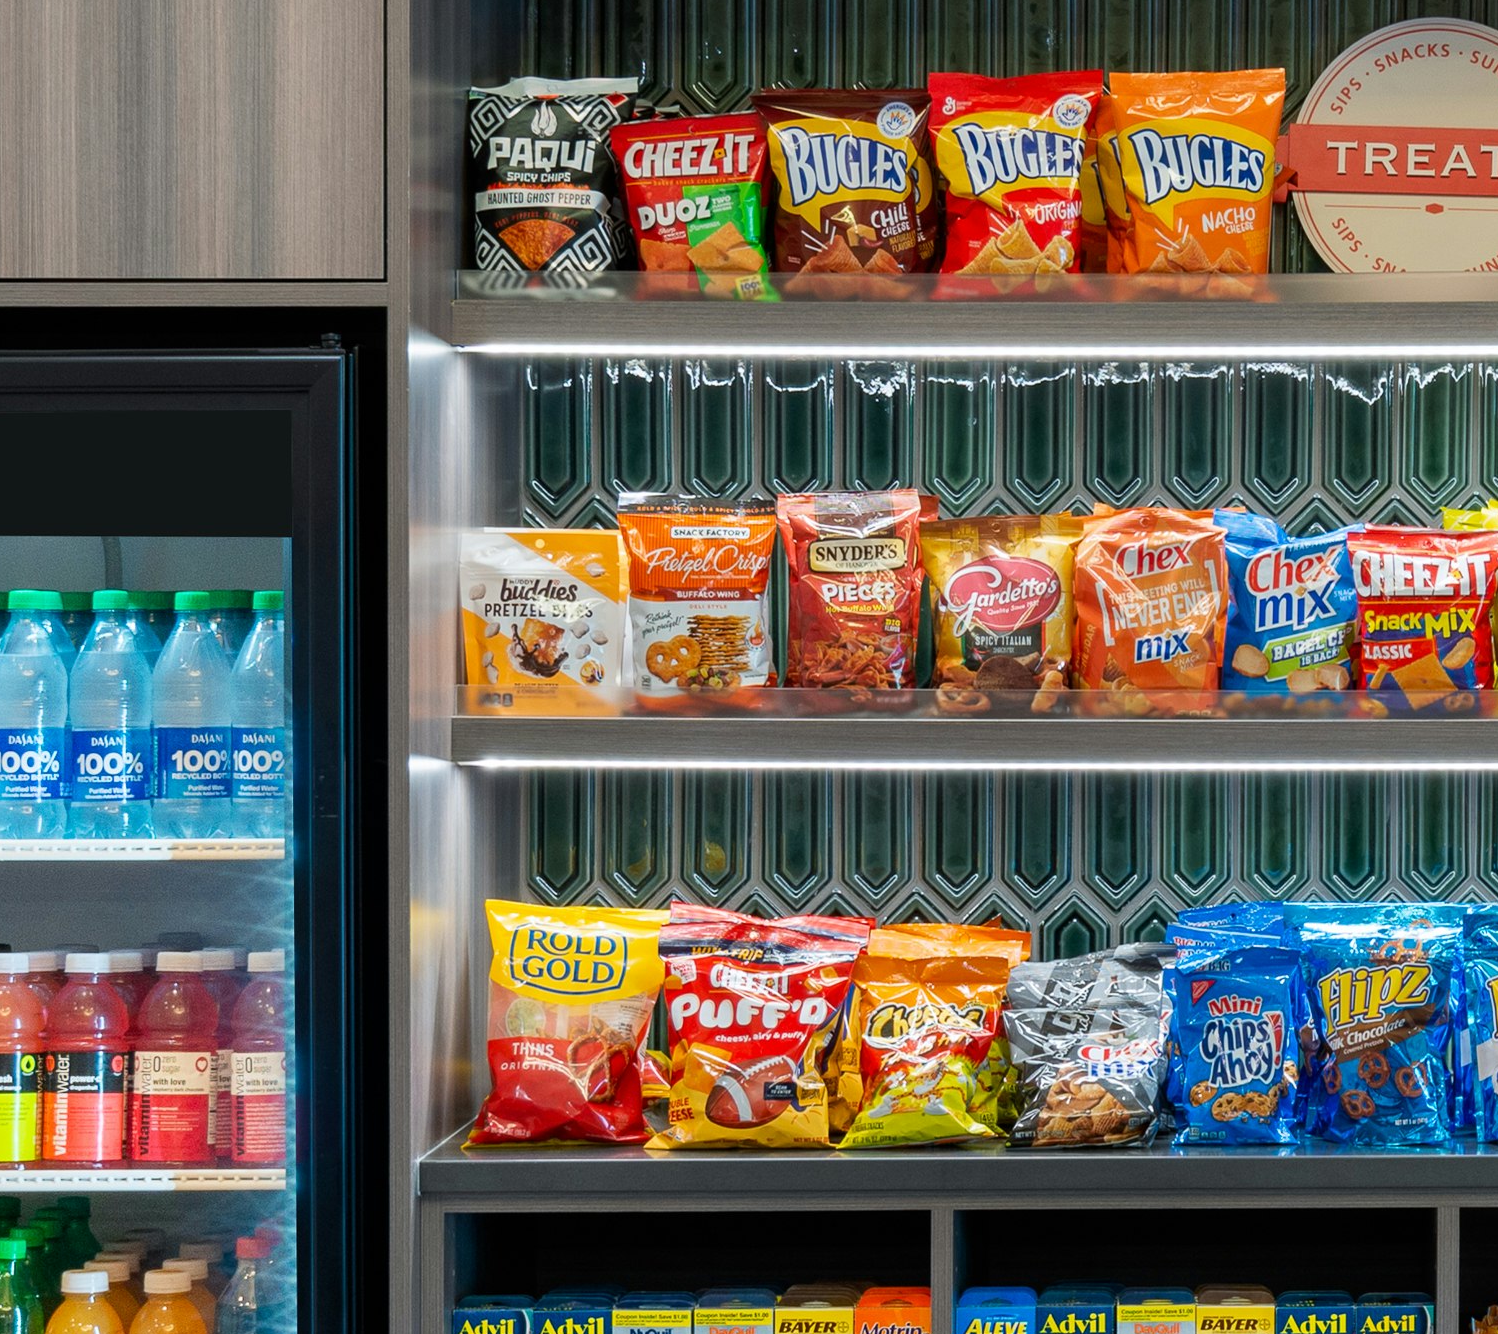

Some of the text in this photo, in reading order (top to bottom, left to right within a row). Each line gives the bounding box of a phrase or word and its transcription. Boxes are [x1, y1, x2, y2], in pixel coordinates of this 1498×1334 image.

[1329, 77, 1363, 116] SIPS
[1373, 43, 1451, 75] SNACKS
[788, 126, 908, 206] BUGLES
[953, 122, 1084, 195] BUGLES
[1131, 128, 1265, 205] BUGLES
[506, 171, 572, 183] SPICY CHIPS
[487, 192, 592, 207] HAUNTED GHOST PEPPER
[638, 196, 711, 230] DUOZ
[1202, 207, 1256, 233] NACHO
[1331, 216, 1363, 250] SIPS
[815, 543, 898, 564] SNYDER'S
[1114, 540, 1193, 580] Chex
[500, 578, 578, 604] buddies
[824, 582, 897, 603] PIECES
[944, 565, 1059, 638] Gardetto's
[484, 604, 546, 618] PRETZEL
[1255, 588, 1337, 632] mix
[1134, 627, 1192, 664] mix
[526, 929, 617, 957] ROLD
[523, 956, 616, 985] GOLD
[672, 993, 828, 1031] PUFF'D
[1209, 994, 1263, 1017] Mini
[1319, 963, 1431, 1034] Flipz
[512, 1042, 555, 1057] THINS
[1201, 1016, 1271, 1061] Chips
[778, 1321, 837, 1334] BAYER
[1039, 1313, 1106, 1334] Advil
[1200, 1318, 1258, 1332] BAYER
